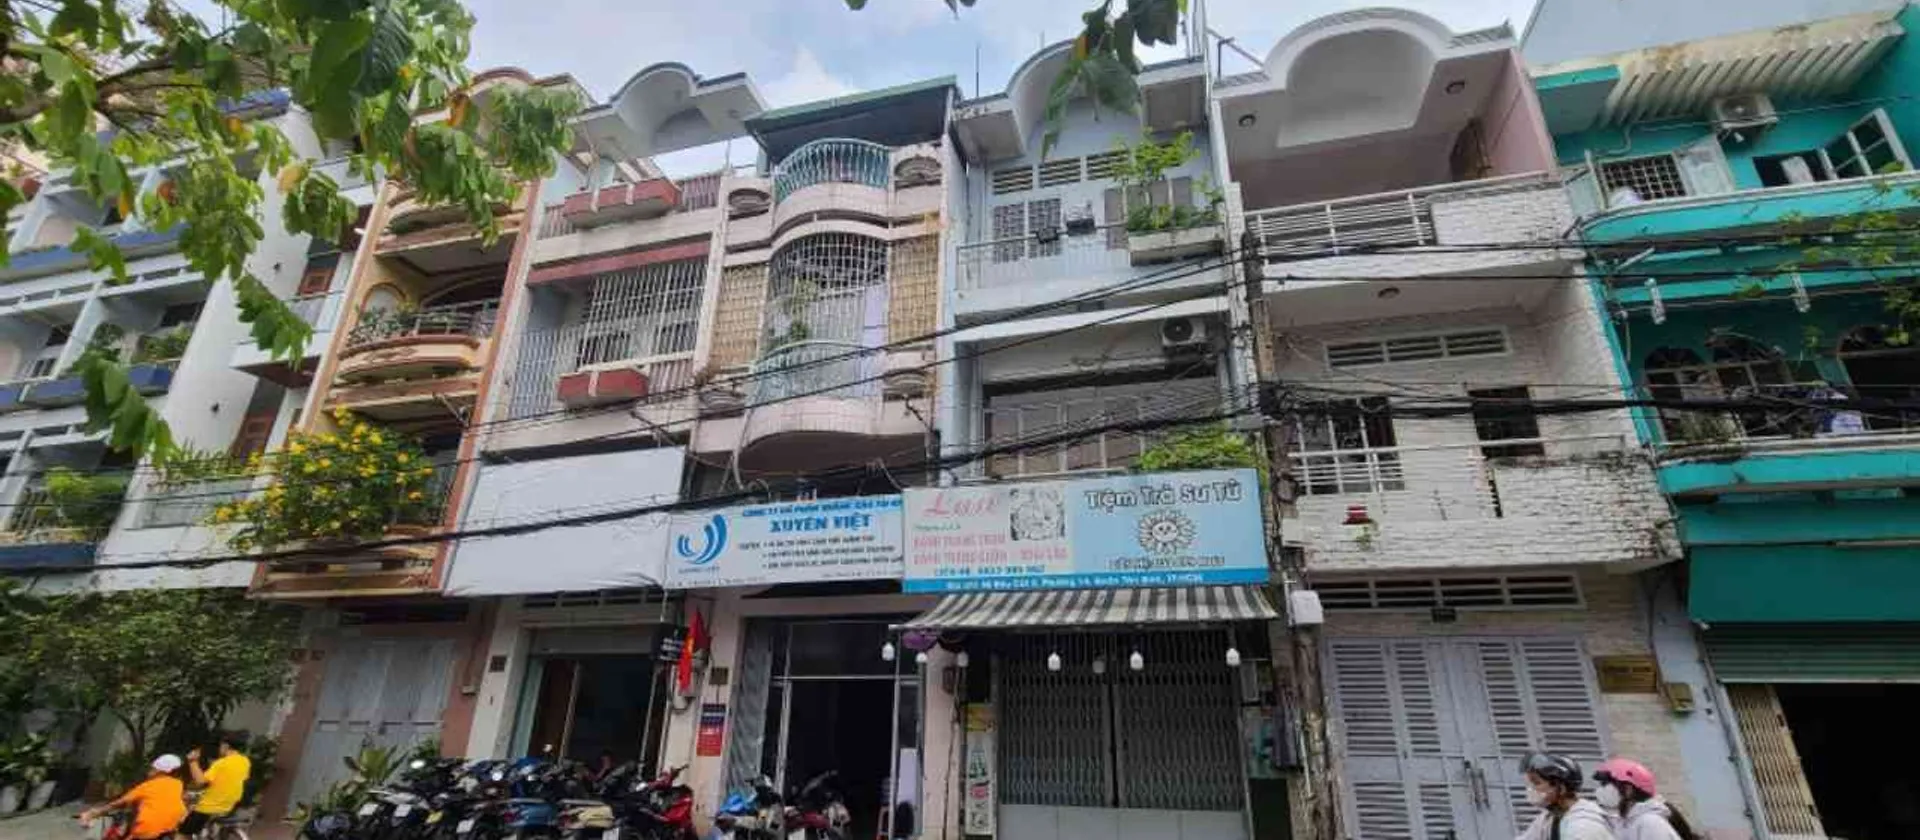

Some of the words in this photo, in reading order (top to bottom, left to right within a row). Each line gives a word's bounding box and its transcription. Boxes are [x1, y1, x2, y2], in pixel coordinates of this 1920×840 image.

[1084, 488, 1139, 514] Tiệm
[1140, 483, 1175, 506] Trà
[1179, 483, 1211, 504] Sư
[1212, 477, 1242, 503] Tử
[770, 513, 828, 533] XUYÊN
[834, 511, 872, 531] VIỆT
